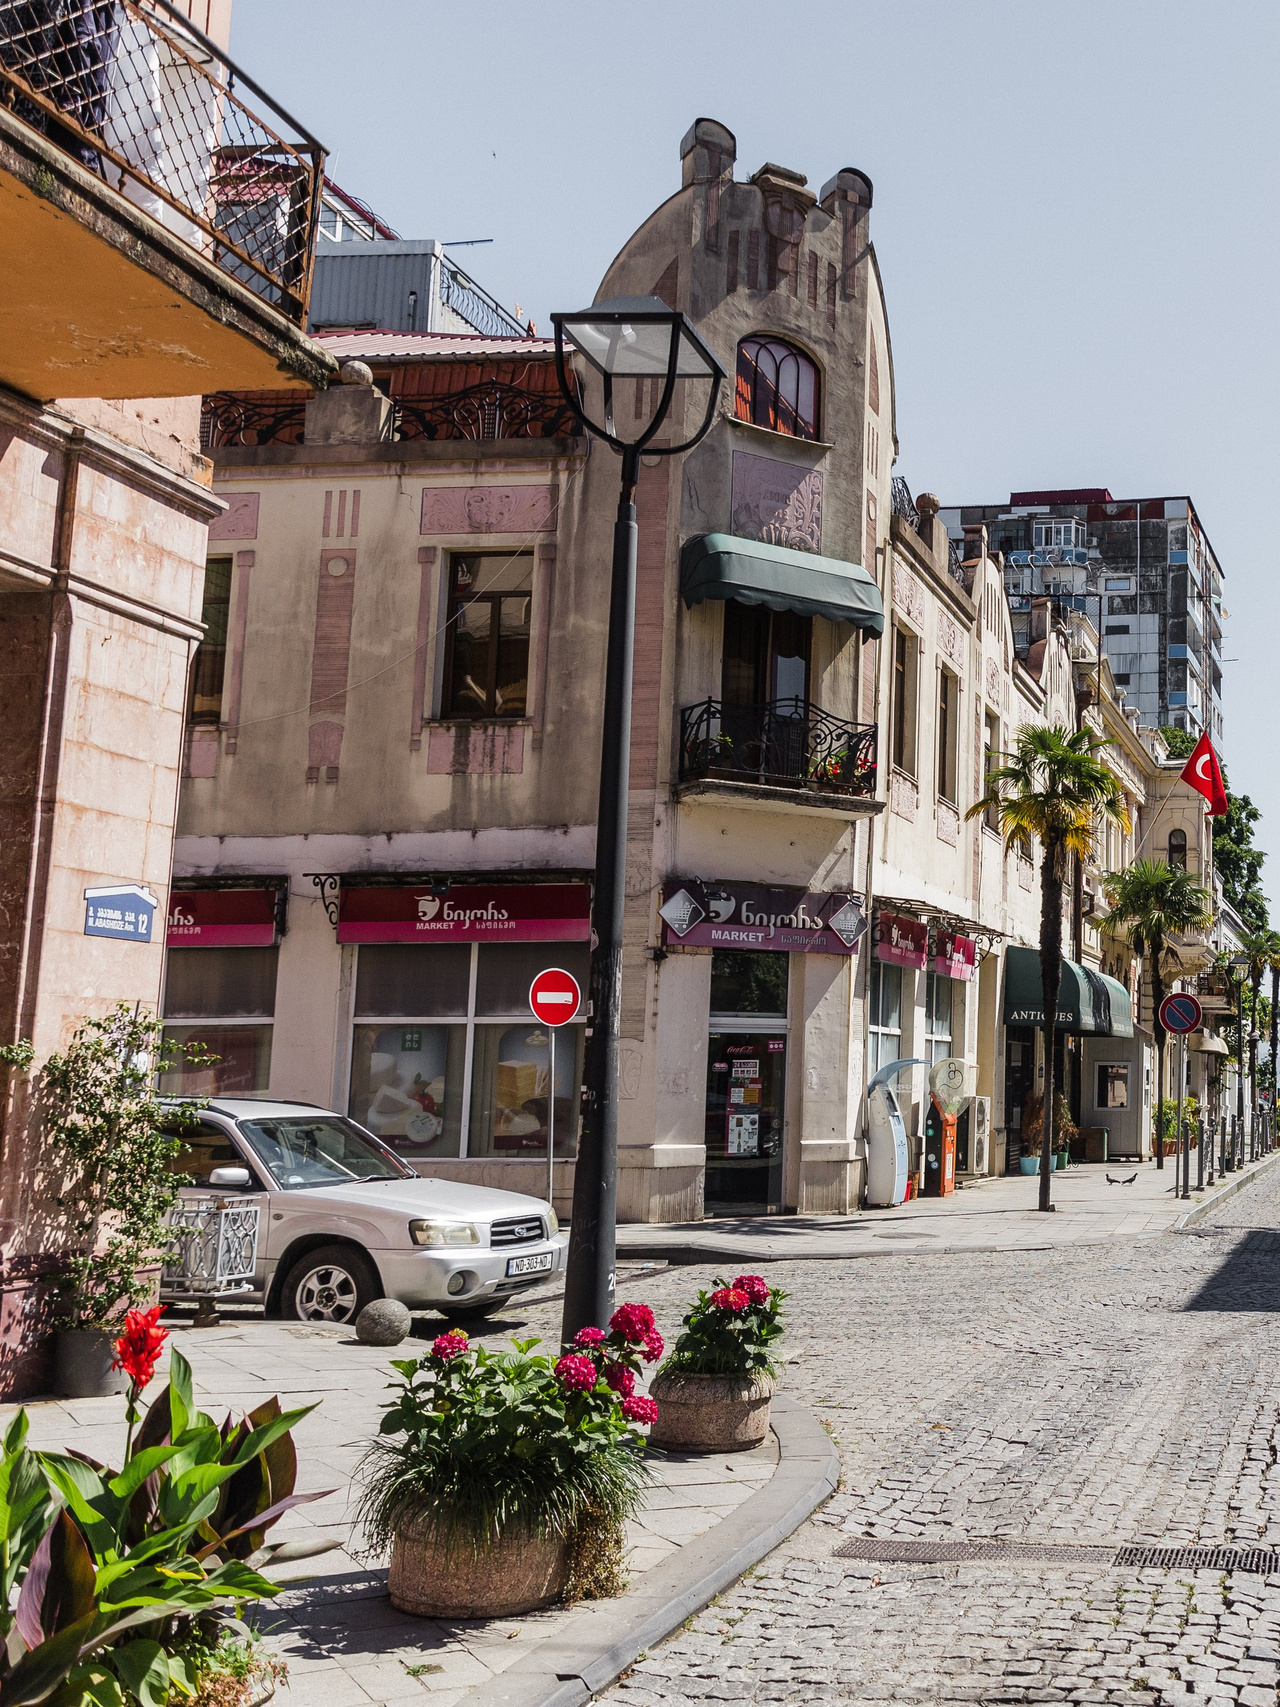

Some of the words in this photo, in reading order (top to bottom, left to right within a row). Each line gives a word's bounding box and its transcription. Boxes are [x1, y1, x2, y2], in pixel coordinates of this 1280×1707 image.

[138, 913, 148, 934] 12
[443, 900, 509, 930] ნიკორა
[740, 900, 824, 939] ნიკორა
[416, 922, 455, 930] MARKET
[711, 929, 765, 943] MARKET
[515, 1255, 548, 1273] ND-303-ND
